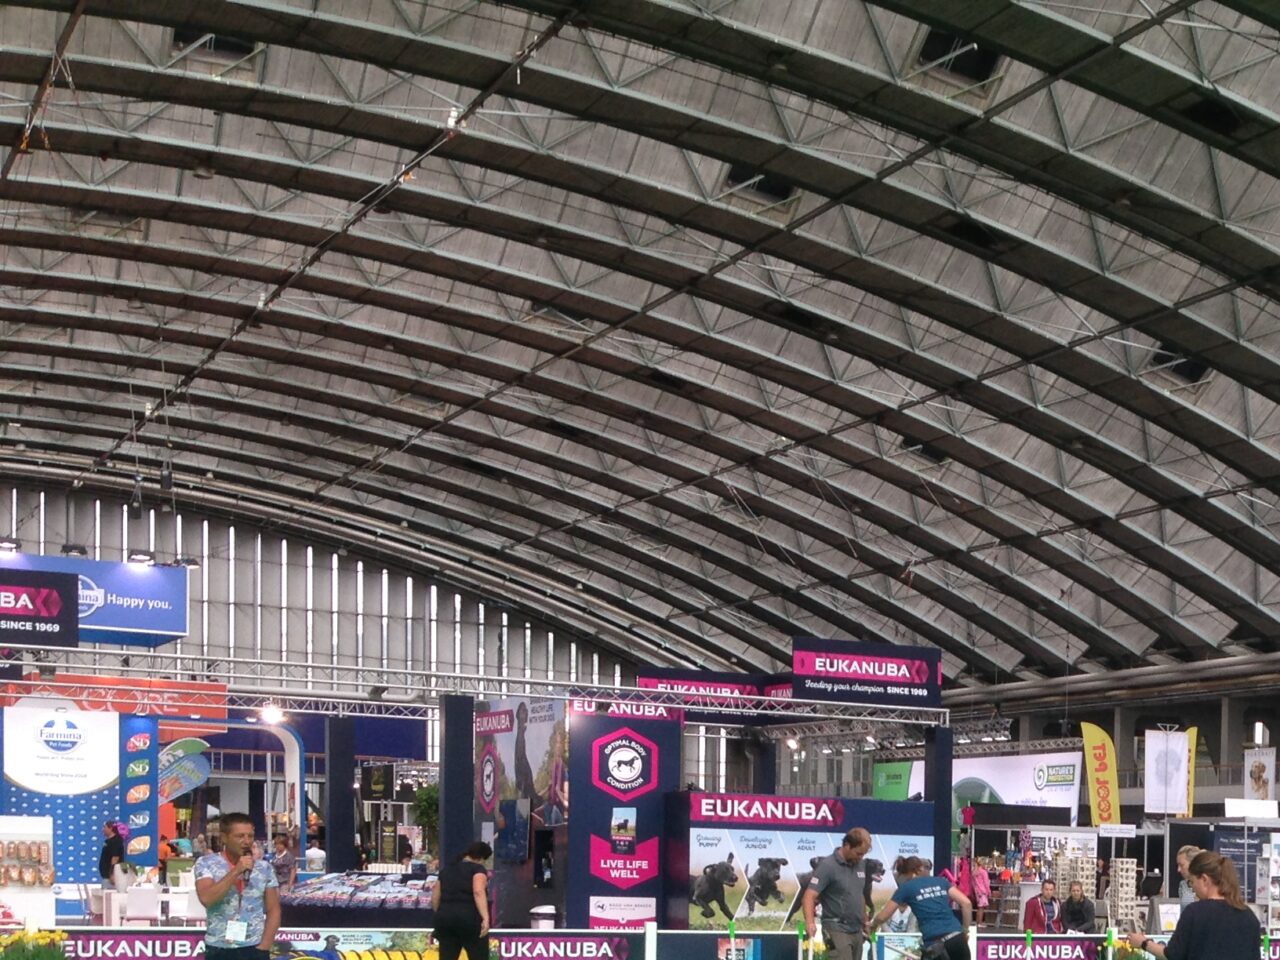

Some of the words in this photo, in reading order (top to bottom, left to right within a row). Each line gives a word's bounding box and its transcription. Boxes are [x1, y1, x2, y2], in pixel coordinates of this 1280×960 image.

[107, 593, 145, 608] Happy
[147, 598, 173, 610] you.
[0, 620, 33, 631] SINCE
[35, 622, 60, 632] 1969
[814, 658, 910, 678] EUKANUBA
[805, 680, 833, 692] Feeding
[833, 683, 850, 692] your
[852, 683, 885, 694] champion
[887, 686, 909, 695] SINCE
[911, 688, 928, 696] 1969
[573, 700, 667, 717] EUANUBA
[476, 713, 511, 732] EUKANUBA
[40, 729, 82, 740] Farmina
[604, 739, 630, 755] OPTIMAL
[630, 742, 647, 757] BODY
[606, 776, 644, 790] CONDITION
[701, 798, 833, 821] EUKANUBA
[601, 859, 624, 868] LIVE
[627, 861, 649, 869] LIFE
[609, 869, 639, 879] WELL
[274, 933, 315, 941] KANUBA
[500, 941, 614, 958] UKANUBA
[987, 944, 1085, 959] EUKANUBA
